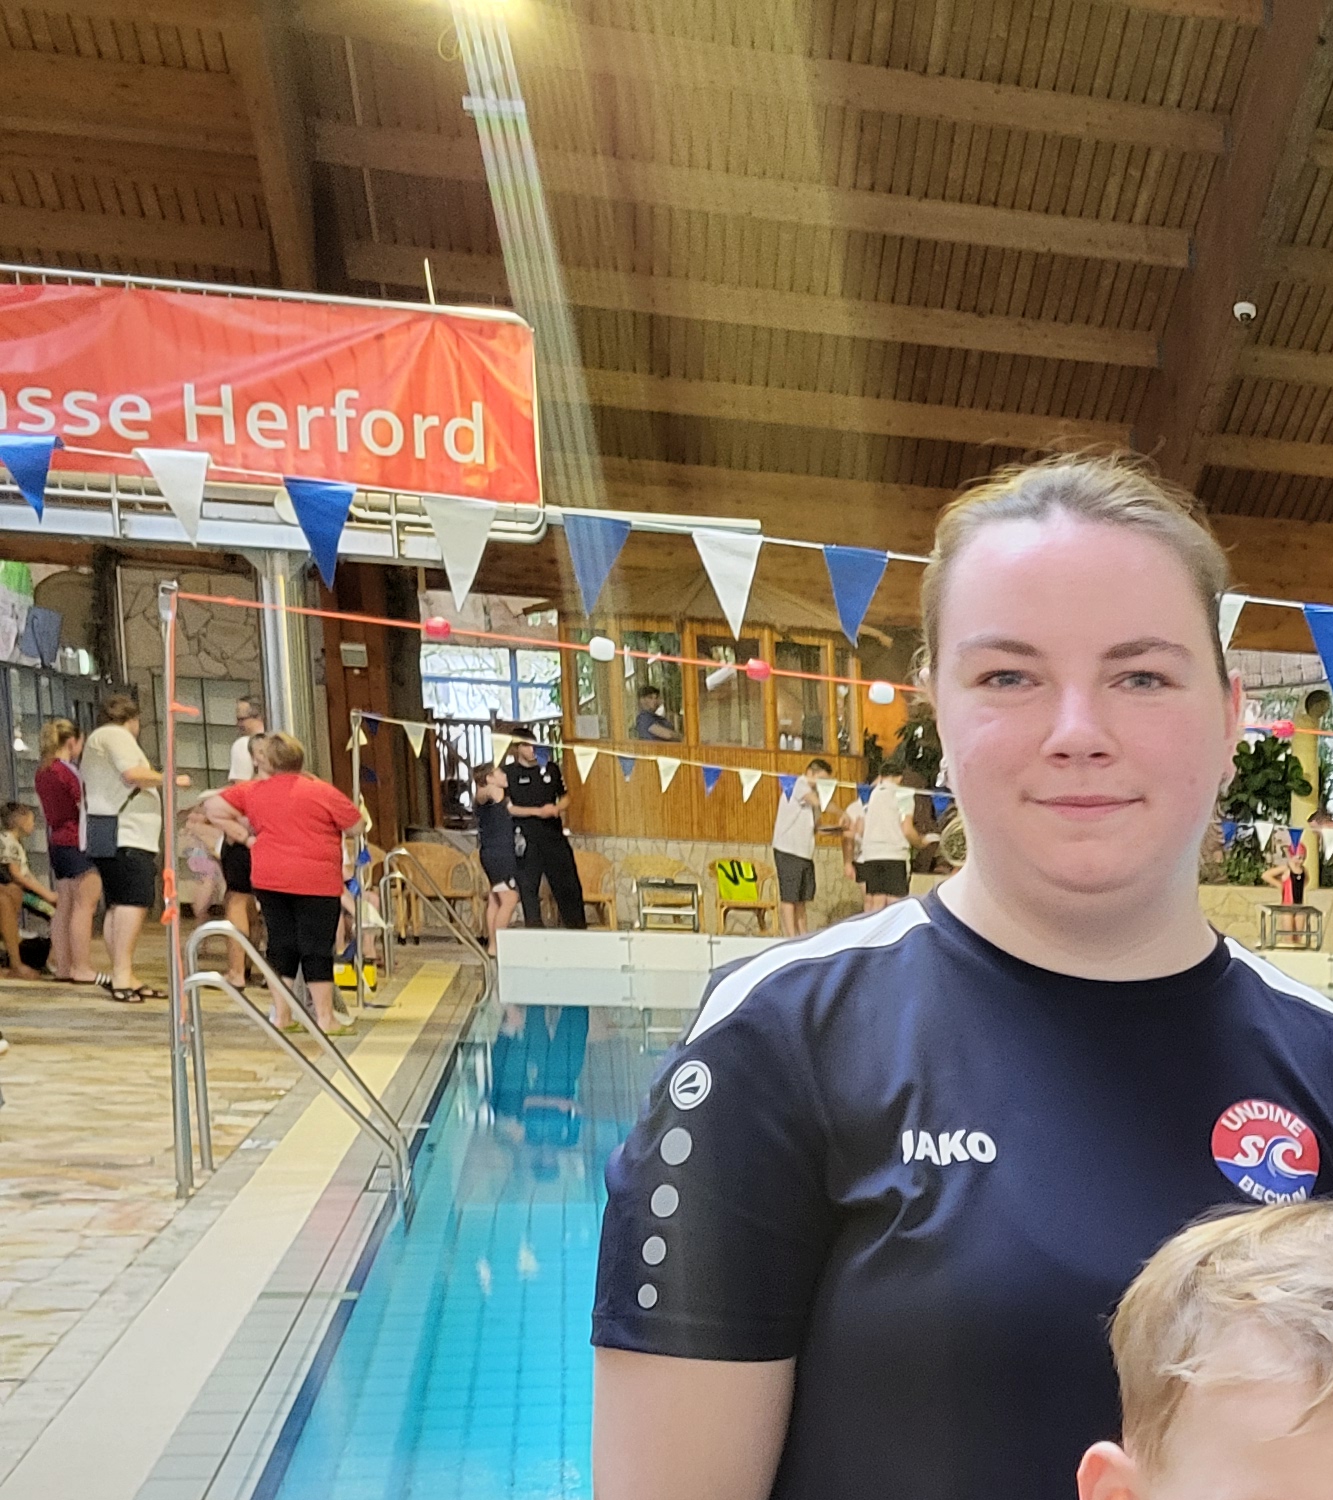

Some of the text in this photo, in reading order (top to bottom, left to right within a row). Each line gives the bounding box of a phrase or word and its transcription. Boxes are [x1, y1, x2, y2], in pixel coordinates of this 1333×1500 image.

[0, 383, 485, 464] sse Herford
[1221, 1101, 1306, 1137] UNDINE
[902, 1129, 997, 1166] JAKO
